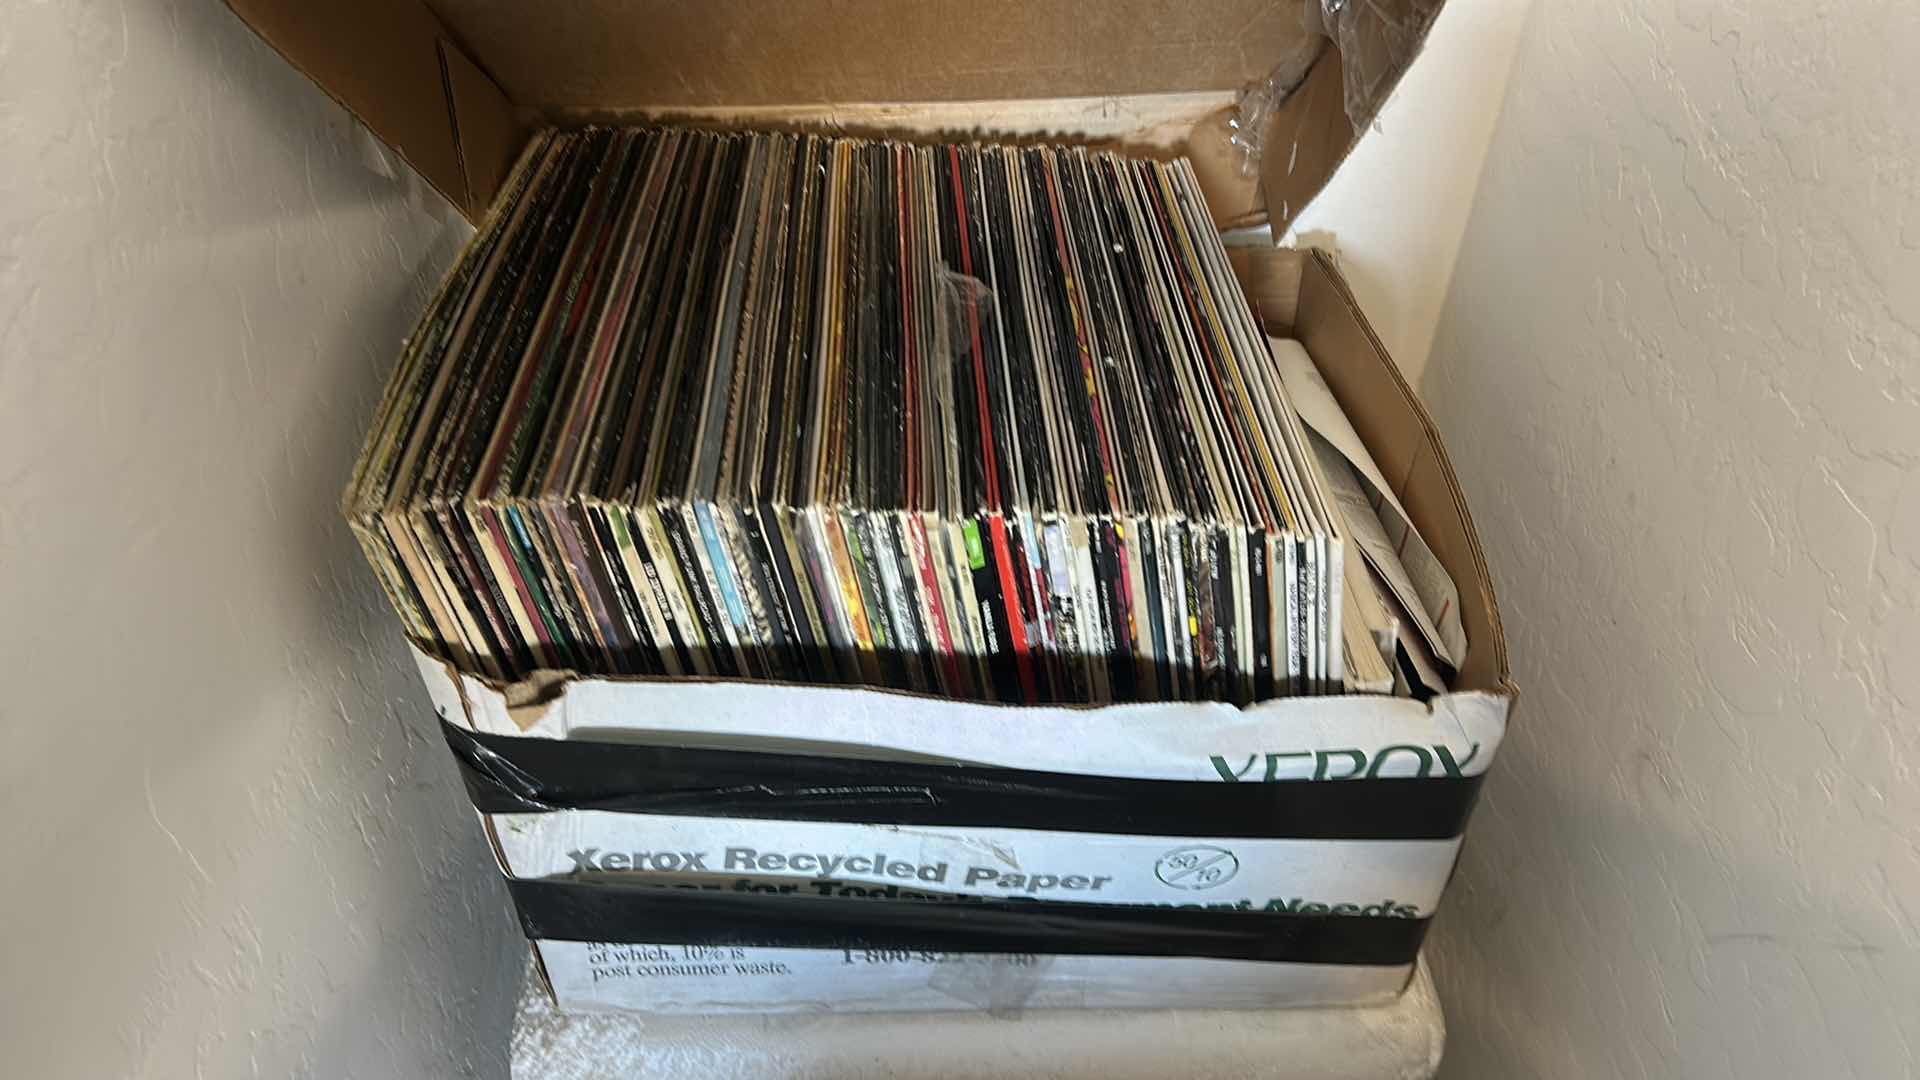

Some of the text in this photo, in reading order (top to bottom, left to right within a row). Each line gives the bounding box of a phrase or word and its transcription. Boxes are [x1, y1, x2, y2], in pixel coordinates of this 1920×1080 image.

[567, 846, 1113, 893] Xerox Recycled Paper
[589, 948, 610, 965] of
[615, 944, 675, 963] which,
[730, 946, 746, 961] is
[591, 959, 793, 983] post consumer waste.
